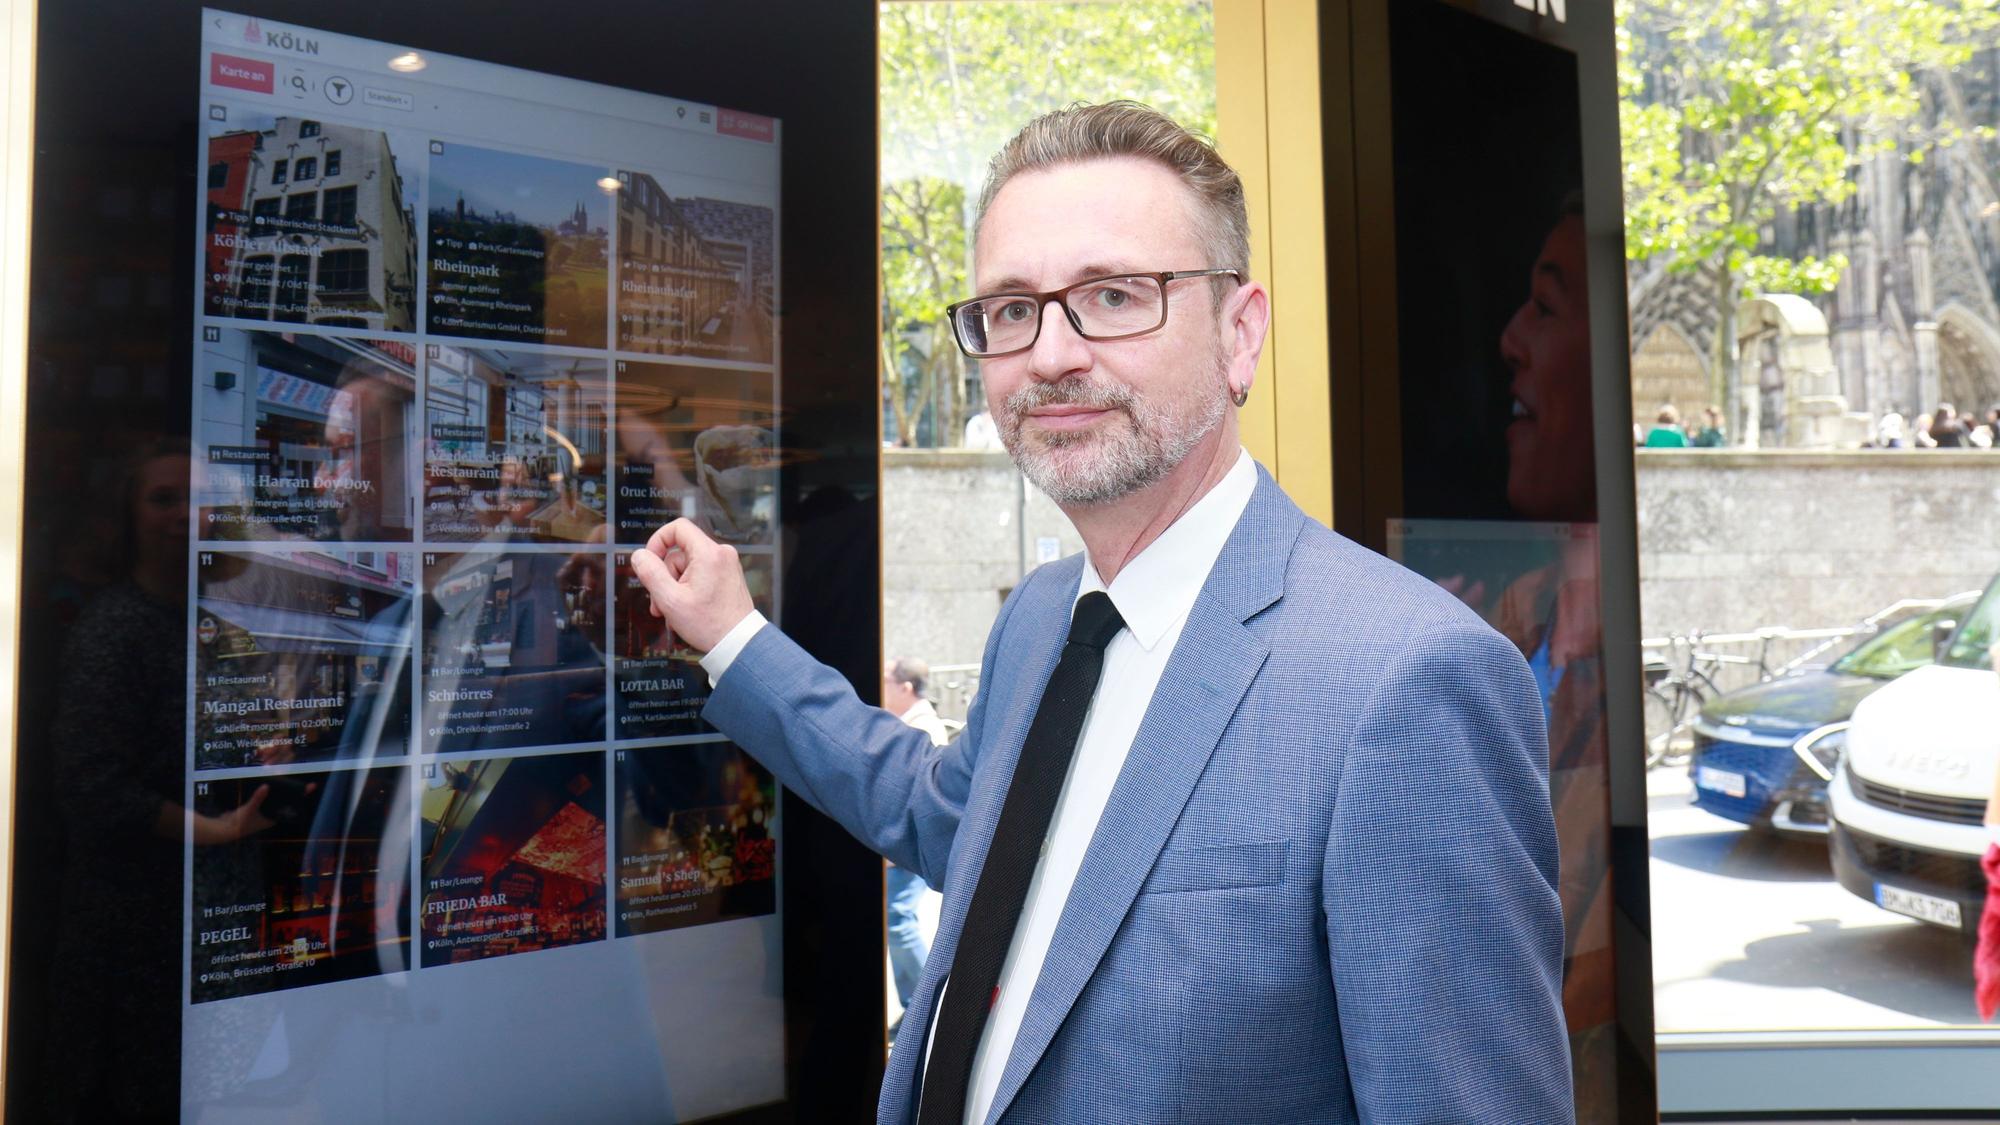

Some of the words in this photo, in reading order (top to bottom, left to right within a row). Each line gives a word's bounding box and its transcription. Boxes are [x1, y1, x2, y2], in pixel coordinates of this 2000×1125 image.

[267, 32, 319, 55] KÖLN
[220, 64, 249, 80] Karte
[250, 70, 265, 82] an
[229, 213, 248, 223] Tipp
[266, 218, 317, 230] Historischer
[318, 223, 358, 234] Stadtkern
[214, 233, 265, 251] Kölner
[268, 240, 324, 258] Altstadt
[446, 240, 463, 249] Tipp
[433, 259, 500, 278] Rheinpark
[469, 283, 500, 294] geöffnet
[622, 280, 697, 299] Rheinauhafen
[496, 300, 532, 312] Rheinpark
[498, 323, 522, 334] GmbH,
[443, 428, 484, 438] Restaurant
[222, 450, 270, 460] Restaurant
[431, 465, 500, 480] Restaurant
[259, 475, 309, 489] Harran
[313, 476, 342, 492] Doy
[344, 478, 371, 494] Doy
[620, 485, 647, 499] Oruc
[216, 514, 240, 526] Köln,
[440, 667, 484, 677] Bar/Lounge
[218, 675, 266, 686] Restaurant
[620, 679, 660, 692] LOTTA
[661, 678, 685, 690] BAR
[428, 688, 494, 702] Schnörres
[204, 699, 260, 715] Mangal
[264, 696, 343, 711] Restaurant
[651, 700, 670, 709] heute
[462, 710, 484, 720] heute
[499, 708, 519, 718] 17:00
[520, 707, 534, 716] Uhr
[690, 711, 697, 720] 12
[215, 722, 250, 734] schließt
[250, 722, 289, 733] morgen
[289, 721, 300, 729] um
[301, 718, 328, 729] 02:00
[328, 718, 344, 728] Uhr
[456, 722, 525, 736] Dreikönigenstraße
[526, 722, 530, 730] 2
[212, 740, 236, 751] Köln,
[236, 737, 293, 750] Weidengasse
[440, 875, 484, 889] Bar/Lounge
[674, 868, 700, 882] Shep
[214, 902, 267, 916] Bar/Lounge
[427, 897, 478, 915] FRIEDA
[480, 892, 508, 908] BAR
[520, 912, 534, 922] Uhr
[200, 926, 252, 946] PEGEL
[434, 938, 456, 949] Köln,
[456, 932, 504, 946] Antwerpener
[211, 954, 240, 965] öffnet
[240, 950, 266, 961] heute
[268, 948, 282, 958] um
[310, 941, 328, 952] Uhr
[208, 971, 233, 982] Köln,
[234, 964, 275, 978] Brüsseler
[276, 960, 304, 972] Straße
[305, 958, 316, 968] 10
